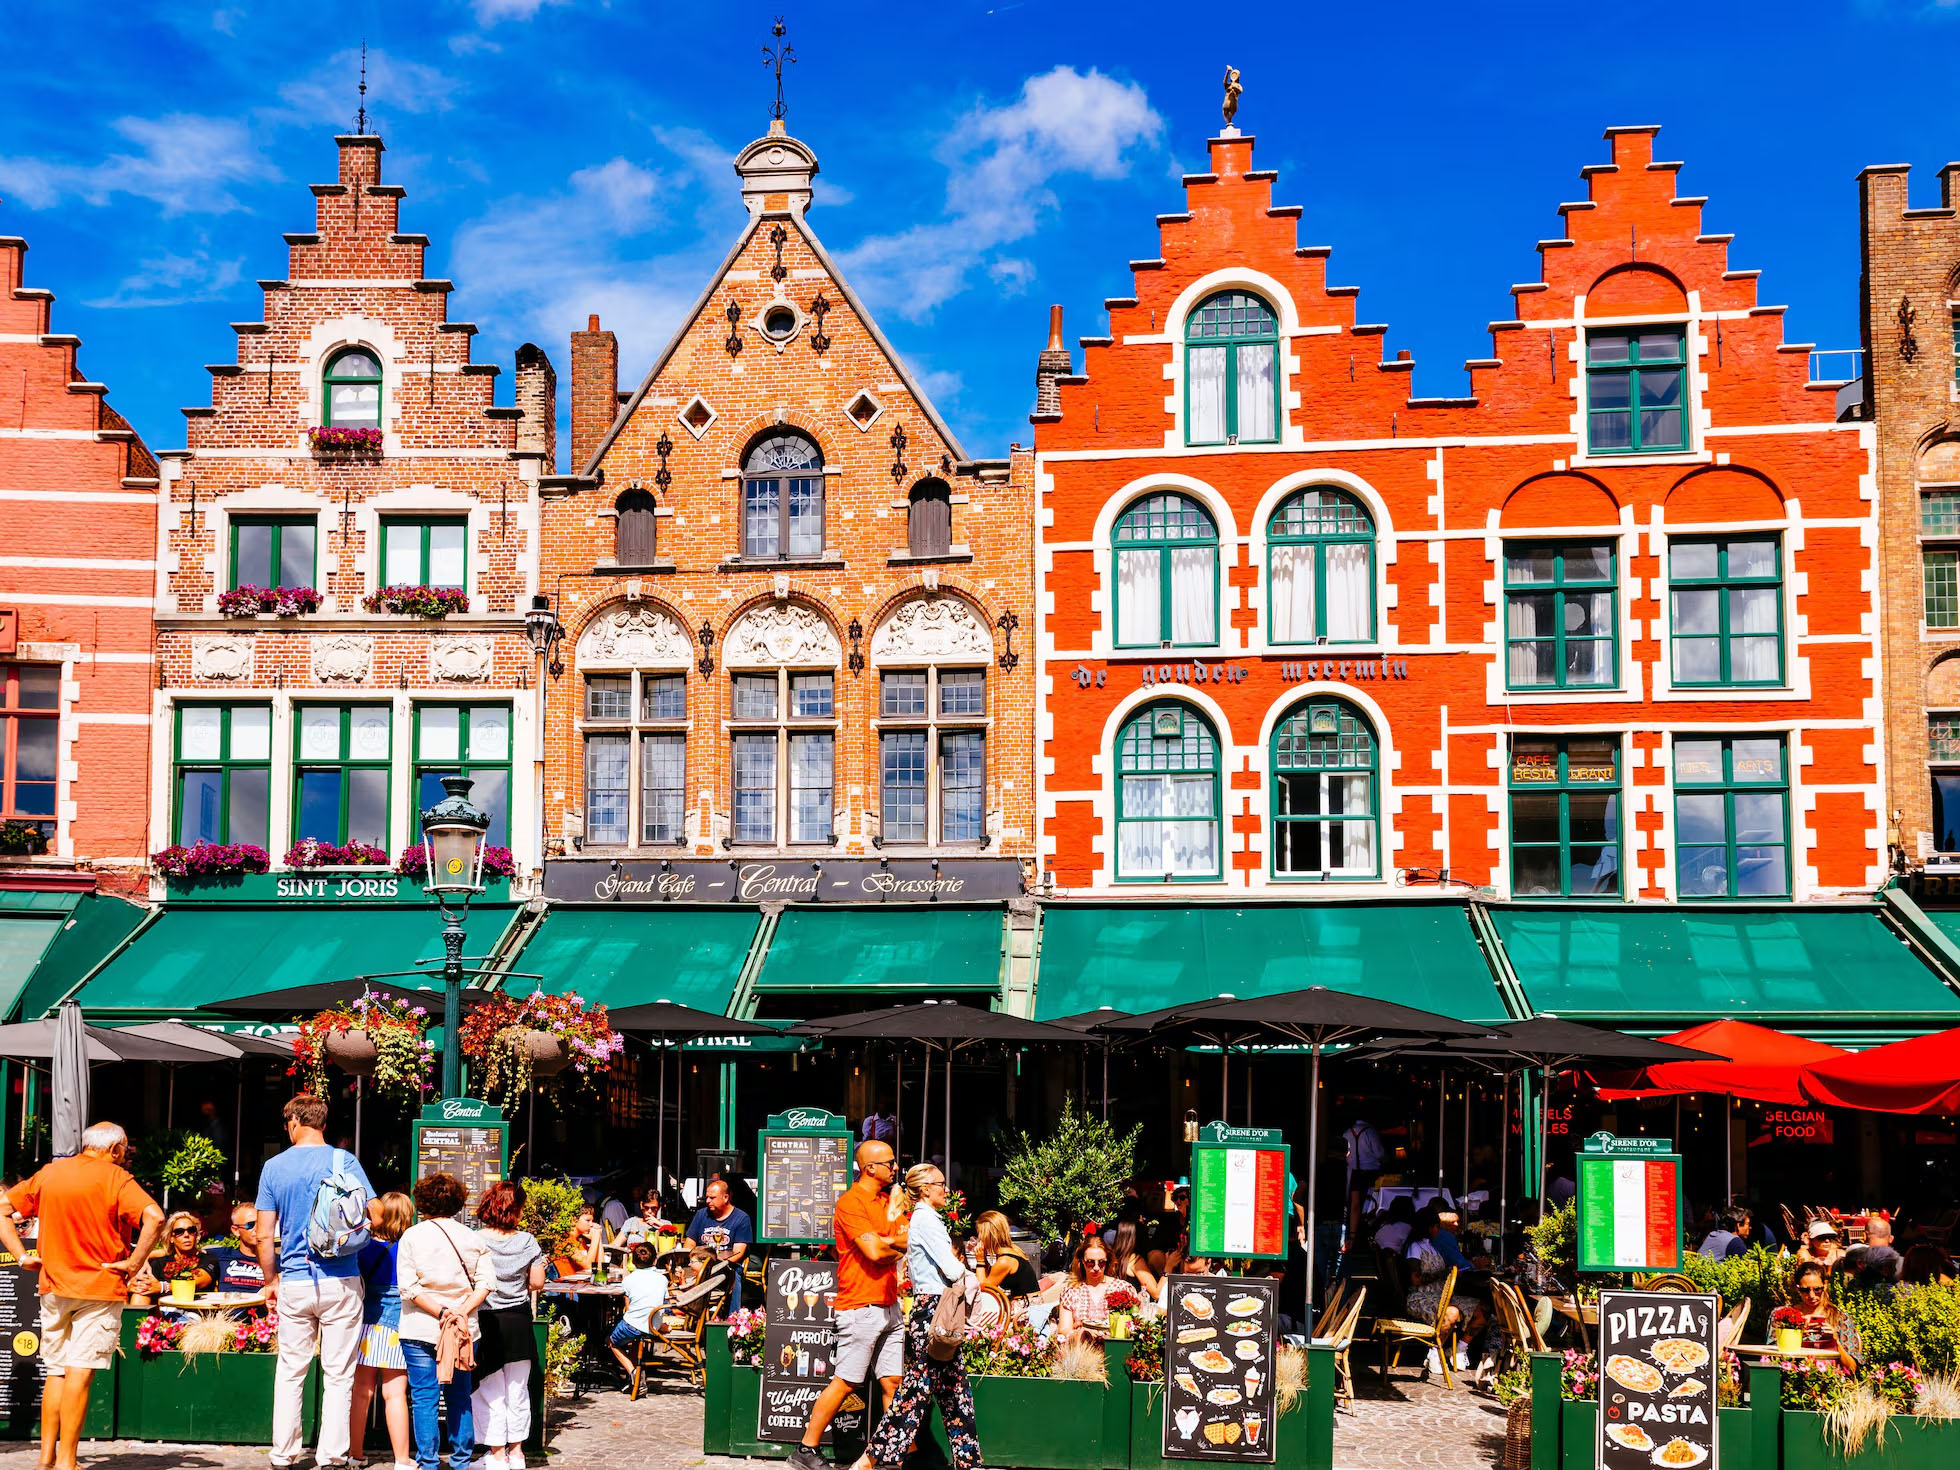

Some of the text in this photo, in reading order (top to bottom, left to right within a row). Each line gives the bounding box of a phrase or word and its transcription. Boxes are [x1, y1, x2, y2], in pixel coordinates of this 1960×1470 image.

[1078, 664, 1107, 687] de
[1282, 653, 1408, 681] meermin
[277, 879, 398, 897] SINT JORIS
[595, 873, 655, 899] Grand
[658, 873, 696, 899] Cafe
[739, 864, 822, 899] Central
[862, 872, 964, 893] Brasserie
[443, 1101, 484, 1119] Central
[788, 1110, 829, 1129] Central
[1225, 1128, 1251, 1136] SIRENE
[1775, 1125, 1816, 1137] FOOD
[771, 1140, 809, 1149] CENTRAL
[777, 1266, 834, 1297] Beer
[1607, 1304, 1697, 1345] PIZZA
[790, 1330, 820, 1345] APERO
[767, 1414, 803, 1428] COFFEE
[1627, 1401, 1709, 1425] PASTA
